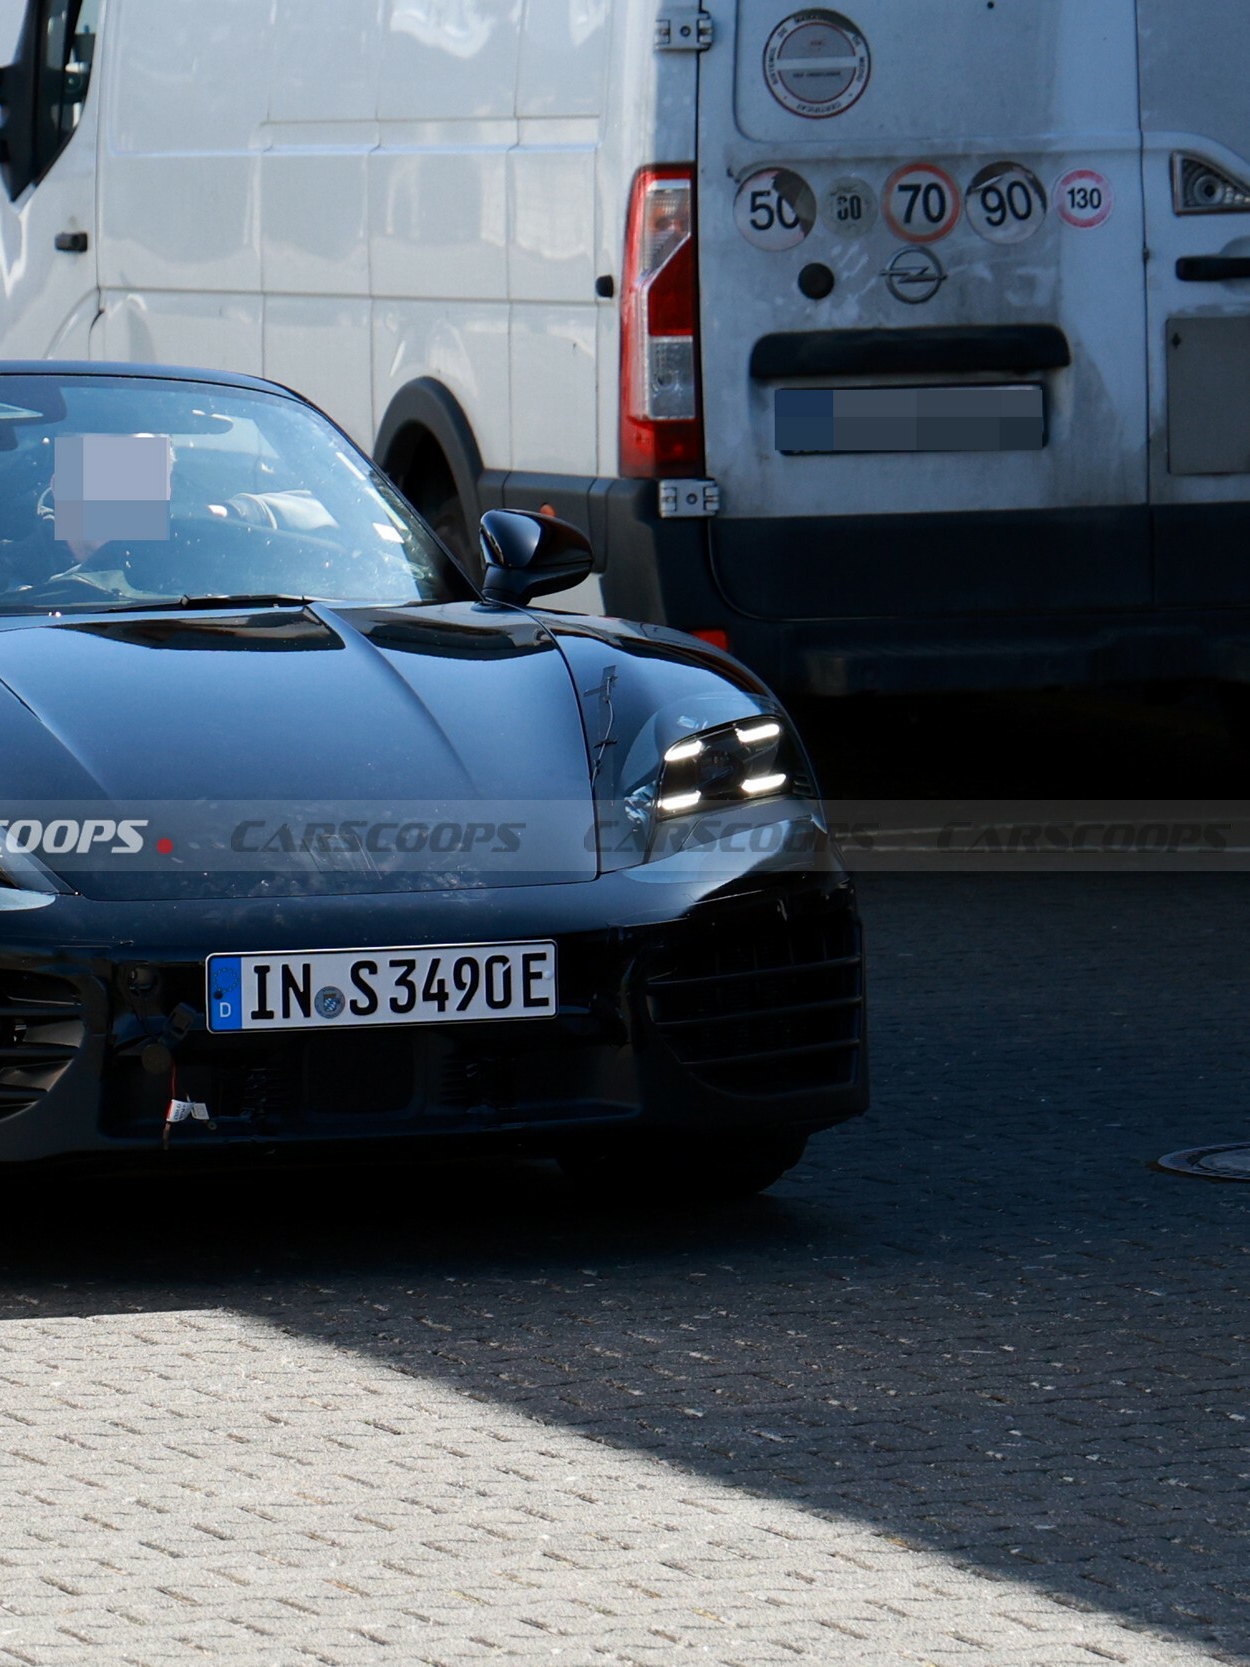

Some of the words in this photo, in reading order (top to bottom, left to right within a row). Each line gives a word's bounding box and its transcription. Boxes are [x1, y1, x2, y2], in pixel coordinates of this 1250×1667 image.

[750, 190, 800, 230] 50
[897, 182, 946, 224] 70
[980, 180, 1032, 226] 90
[1067, 187, 1102, 209] 130
[219, 1002, 232, 1018] D
[250, 963, 312, 1020] IN
